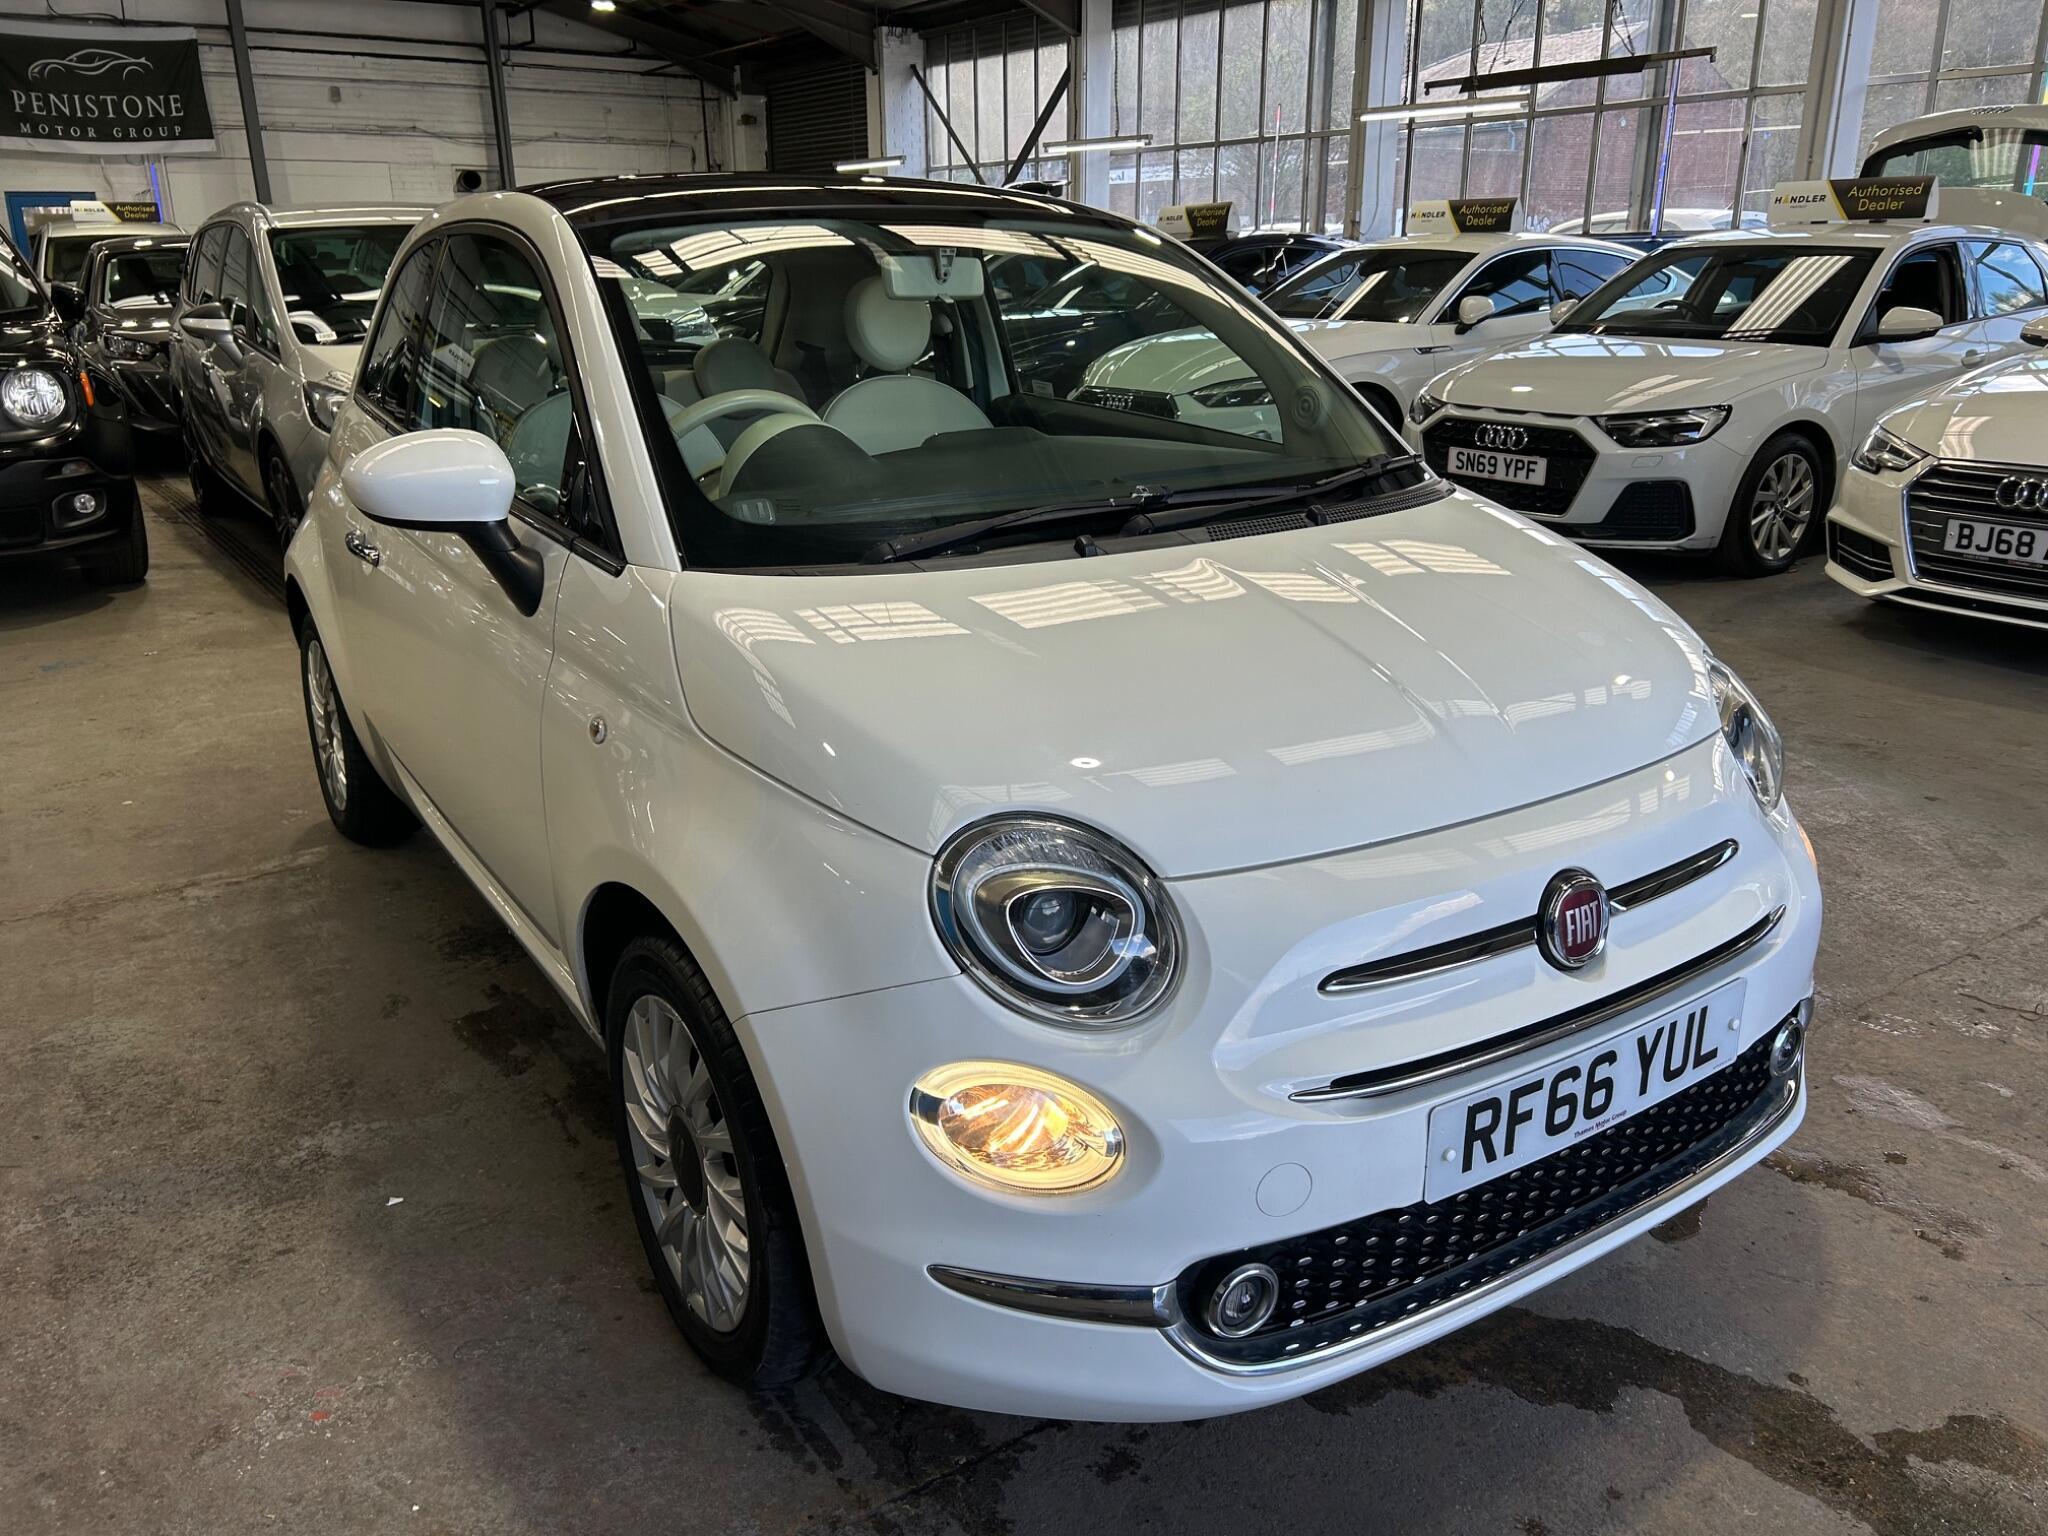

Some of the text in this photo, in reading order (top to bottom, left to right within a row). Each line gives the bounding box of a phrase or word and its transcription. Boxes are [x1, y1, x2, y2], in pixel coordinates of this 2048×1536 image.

[10, 89, 185, 119] PENISTONE
[20, 122, 182, 138] MOTOR GROUP
[1848, 183, 1924, 199] Authorised
[116, 205, 155, 213] Authorised
[1193, 206, 1228, 217] Authorised
[1460, 203, 1510, 214] Authorised
[1858, 199, 1904, 212] Dealer
[1196, 218, 1218, 227] Dealer
[1466, 216, 1496, 226] Dealer
[1456, 451, 1538, 480] SN69 YPF
[1955, 522, 2036, 558] BJ68
[1565, 900, 1599, 947] FIAT
[1461, 1005, 1719, 1174] RF66 YUL
